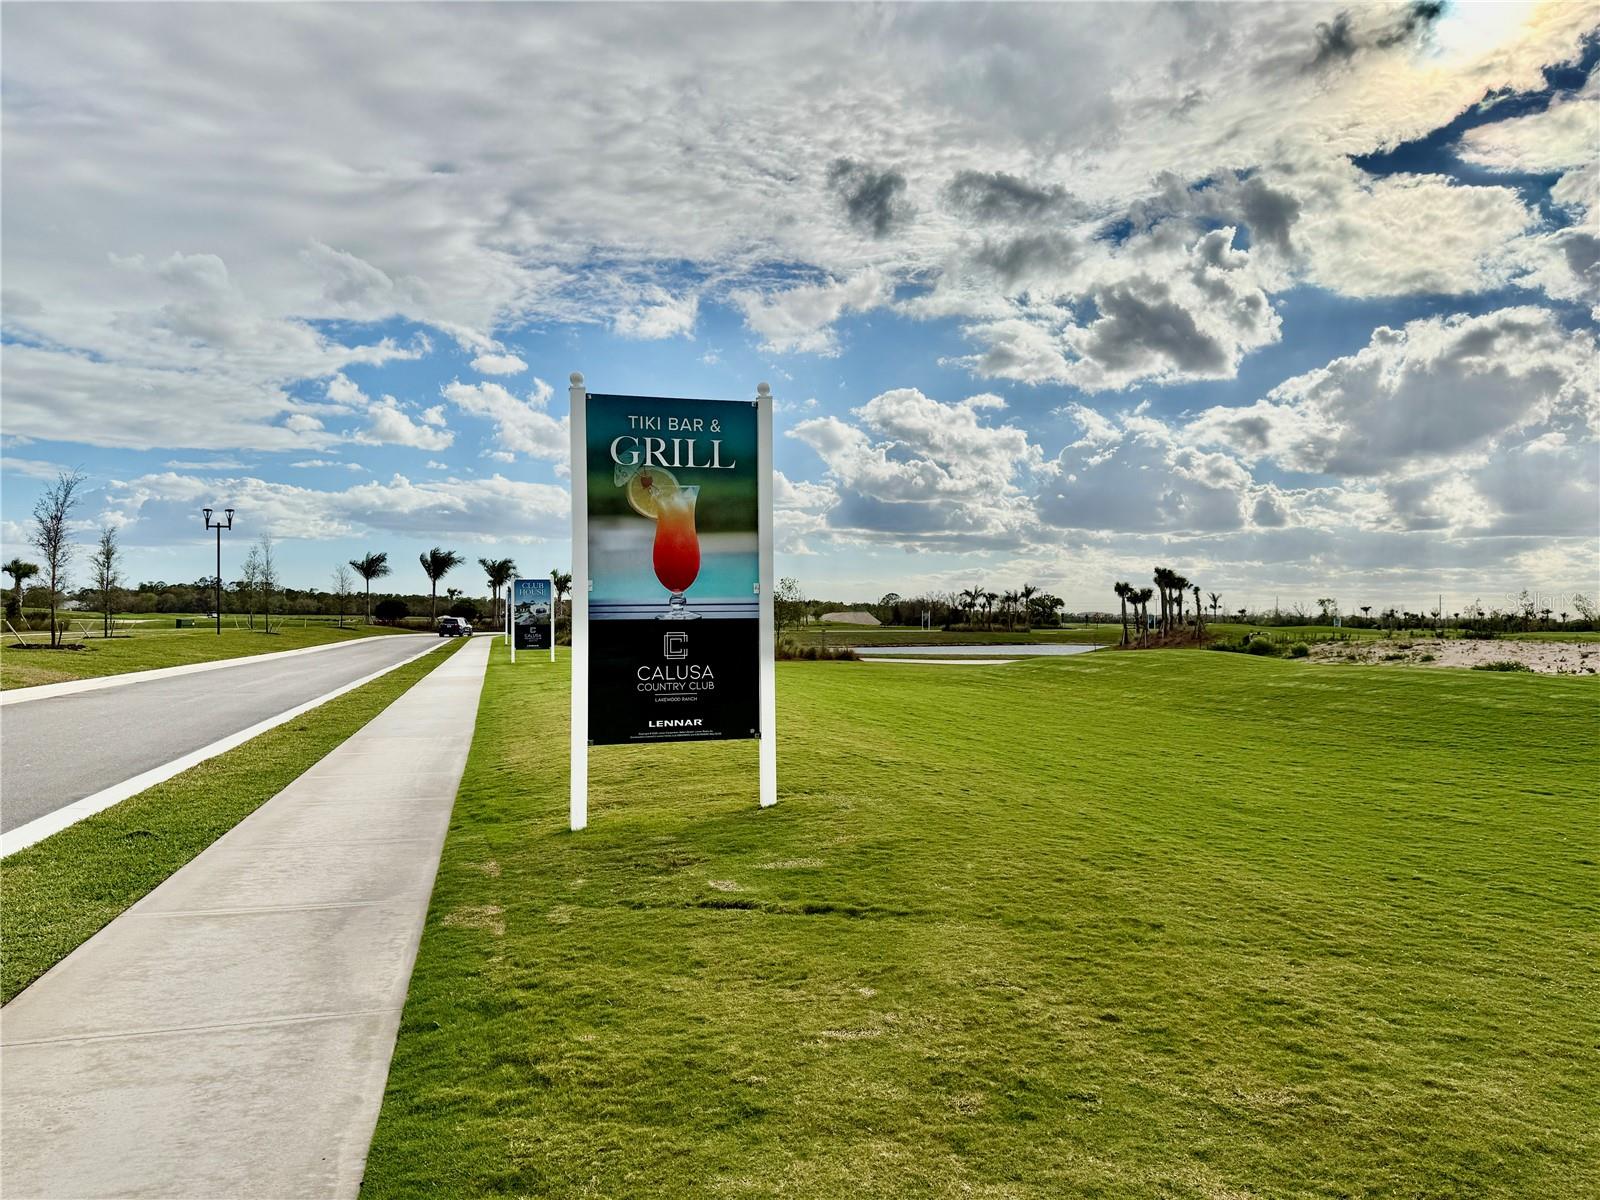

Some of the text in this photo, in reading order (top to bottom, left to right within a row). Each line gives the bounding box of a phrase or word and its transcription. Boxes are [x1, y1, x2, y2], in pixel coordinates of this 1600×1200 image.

[628, 416, 721, 432] TIKI BAR &
[610, 436, 736, 469] GRILL
[637, 665, 714, 680] CALUSA
[637, 681, 715, 691] COUNTRY CLUB
[649, 719, 703, 728] LENNAR
